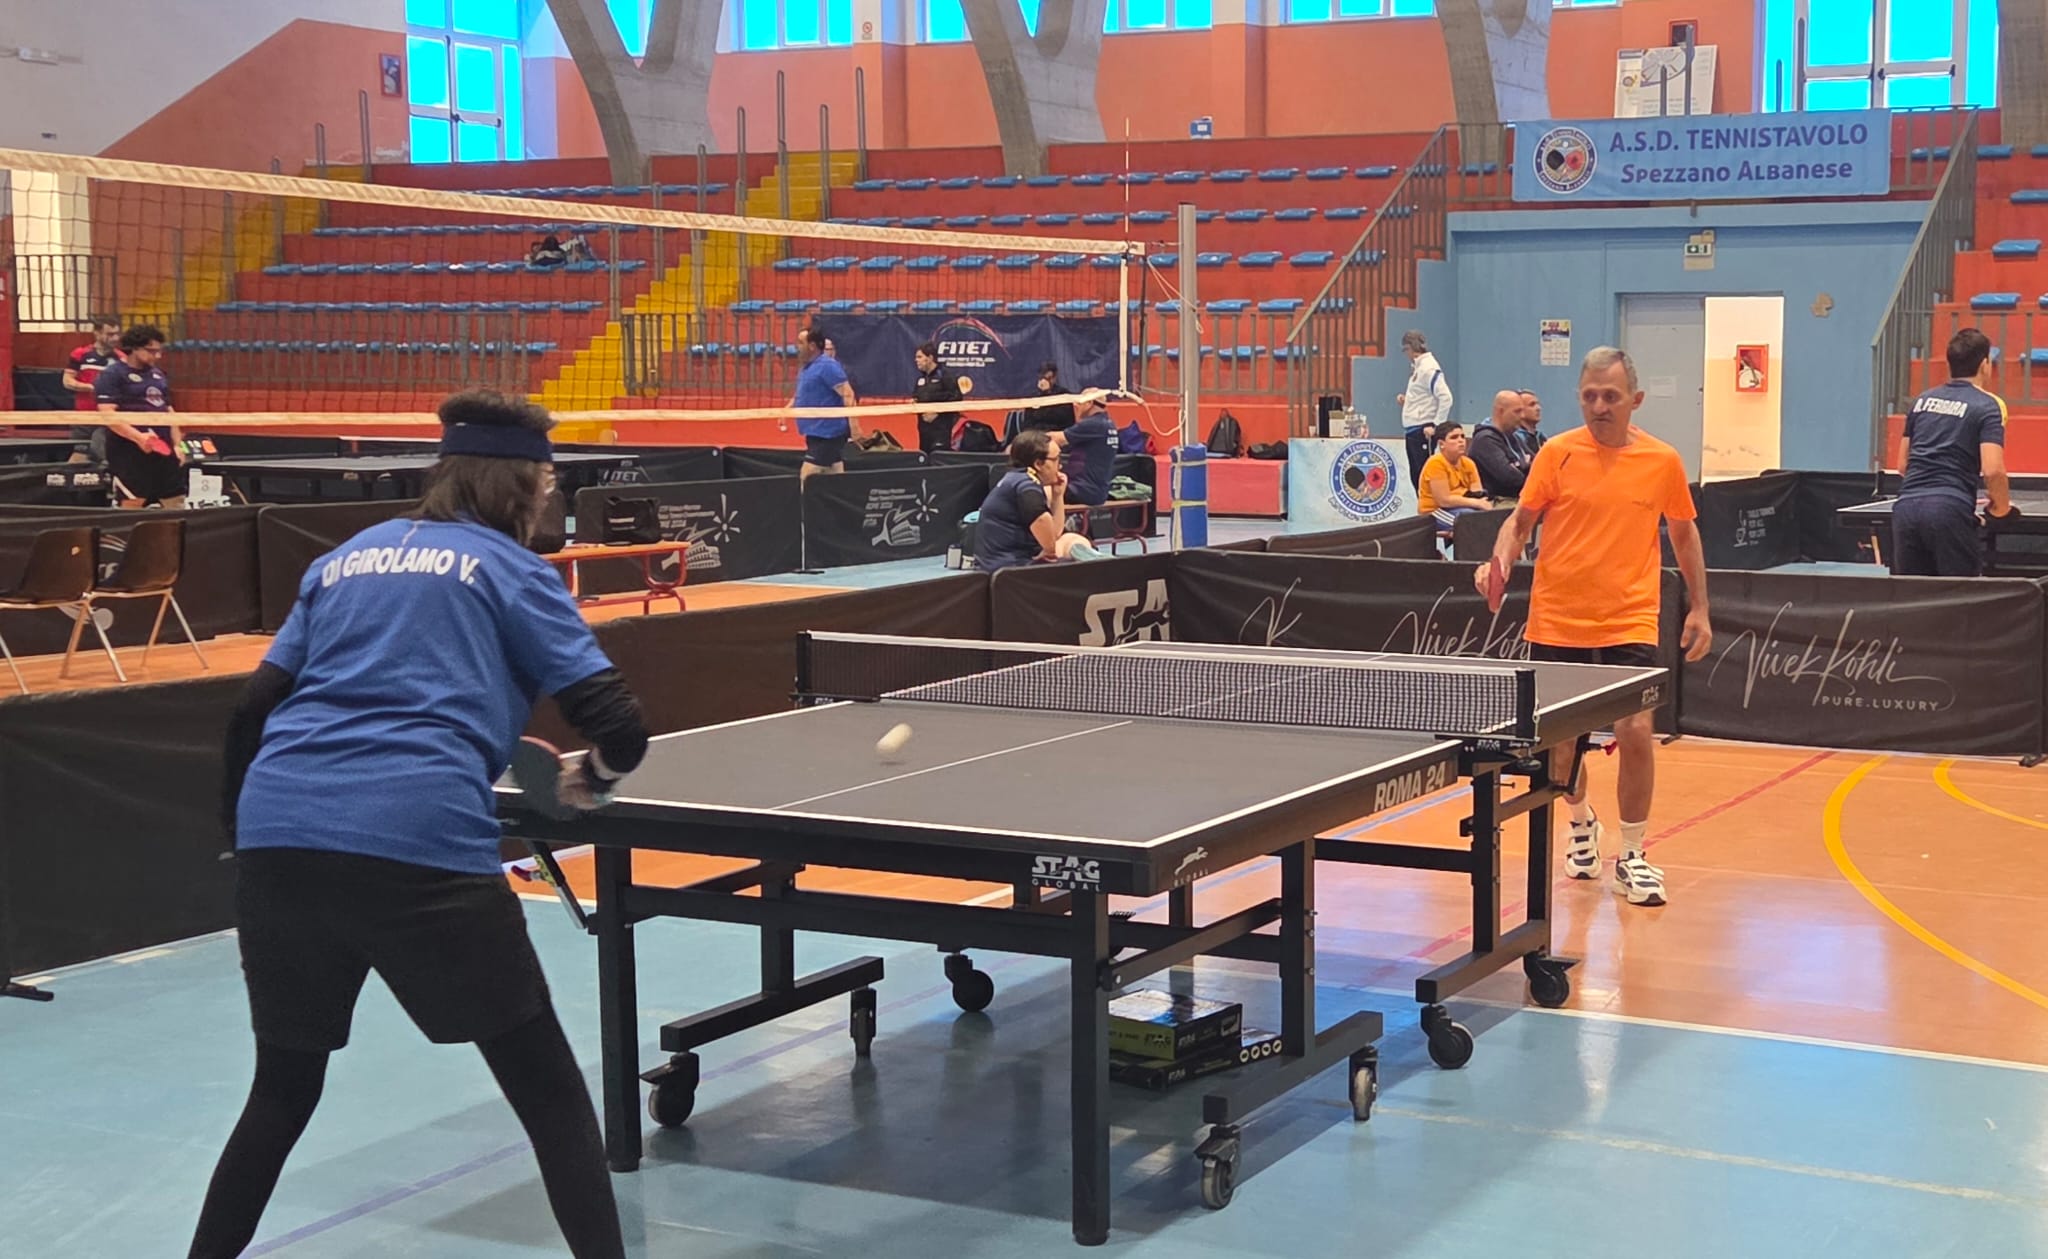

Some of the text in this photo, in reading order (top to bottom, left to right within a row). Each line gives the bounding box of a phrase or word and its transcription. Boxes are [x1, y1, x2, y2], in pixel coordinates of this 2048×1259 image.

[1610, 130, 1679, 153] A.S.D.
[1687, 123, 1868, 151] TENNISTAVOLO
[937, 340, 991, 355] FITET
[321, 547, 480, 588] DI GIROLAMO V.
[1079, 579, 1170, 647] STA
[1480, 593, 1532, 661] Koh
[1708, 601, 1822, 709] Vivek
[1374, 761, 1447, 812] ROMA 24
[1031, 855, 1100, 880] STAG
[1032, 878, 1100, 892] GLOBAL
